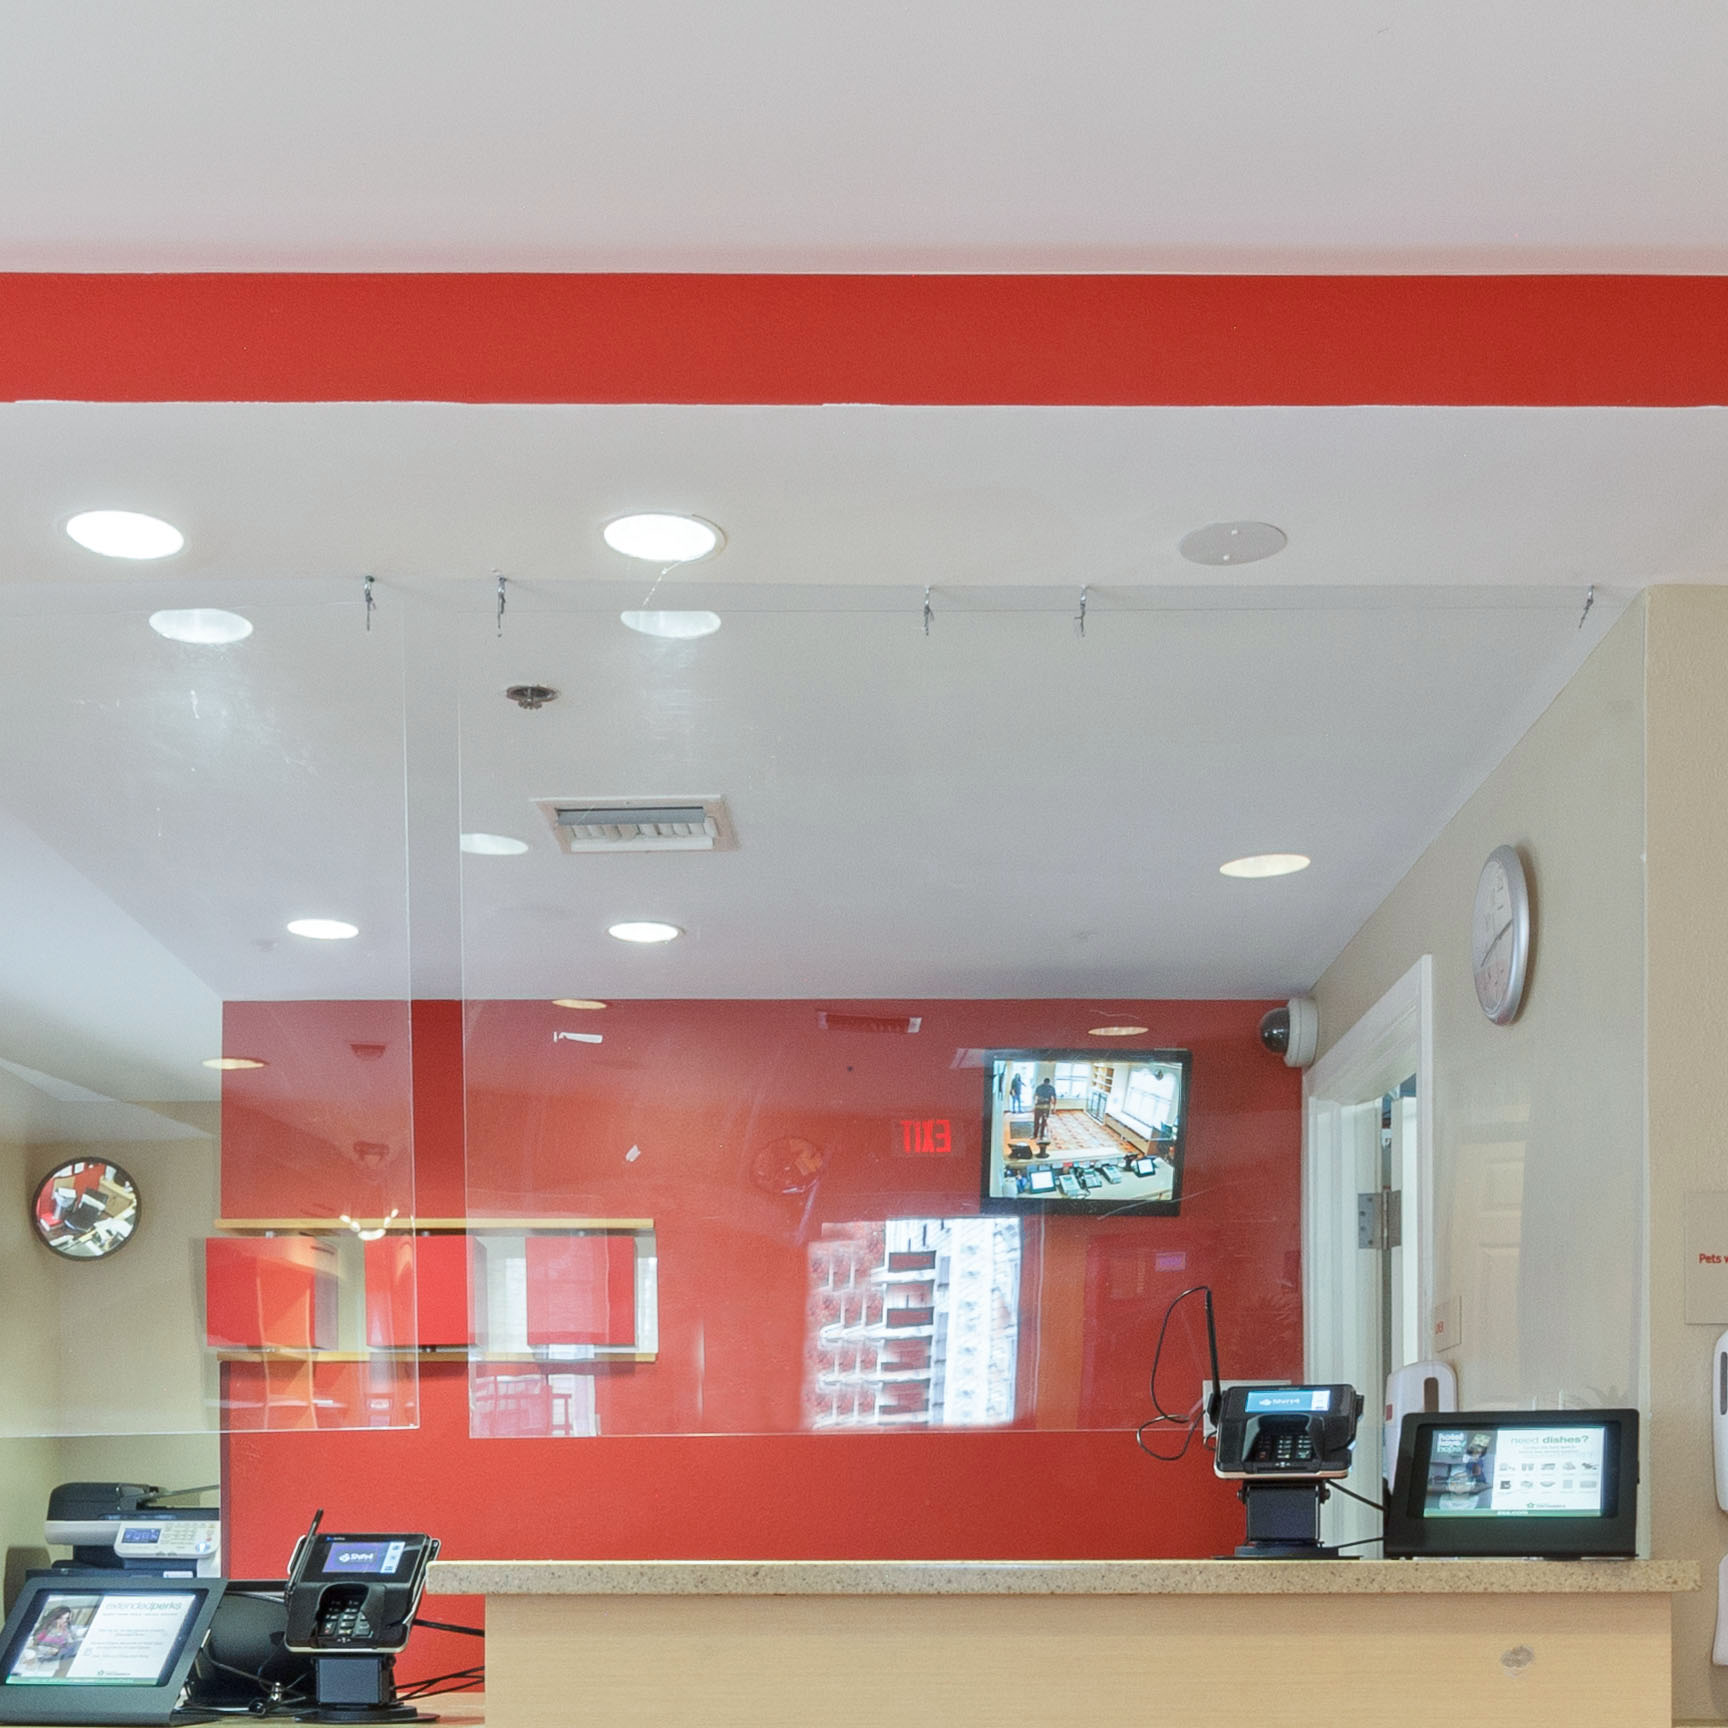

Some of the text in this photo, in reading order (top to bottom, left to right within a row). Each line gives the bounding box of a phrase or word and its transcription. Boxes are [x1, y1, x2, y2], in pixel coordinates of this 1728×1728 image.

[1699, 1253, 1722, 1264] Pets
[1511, 1435, 1589, 1444] need dishes?
